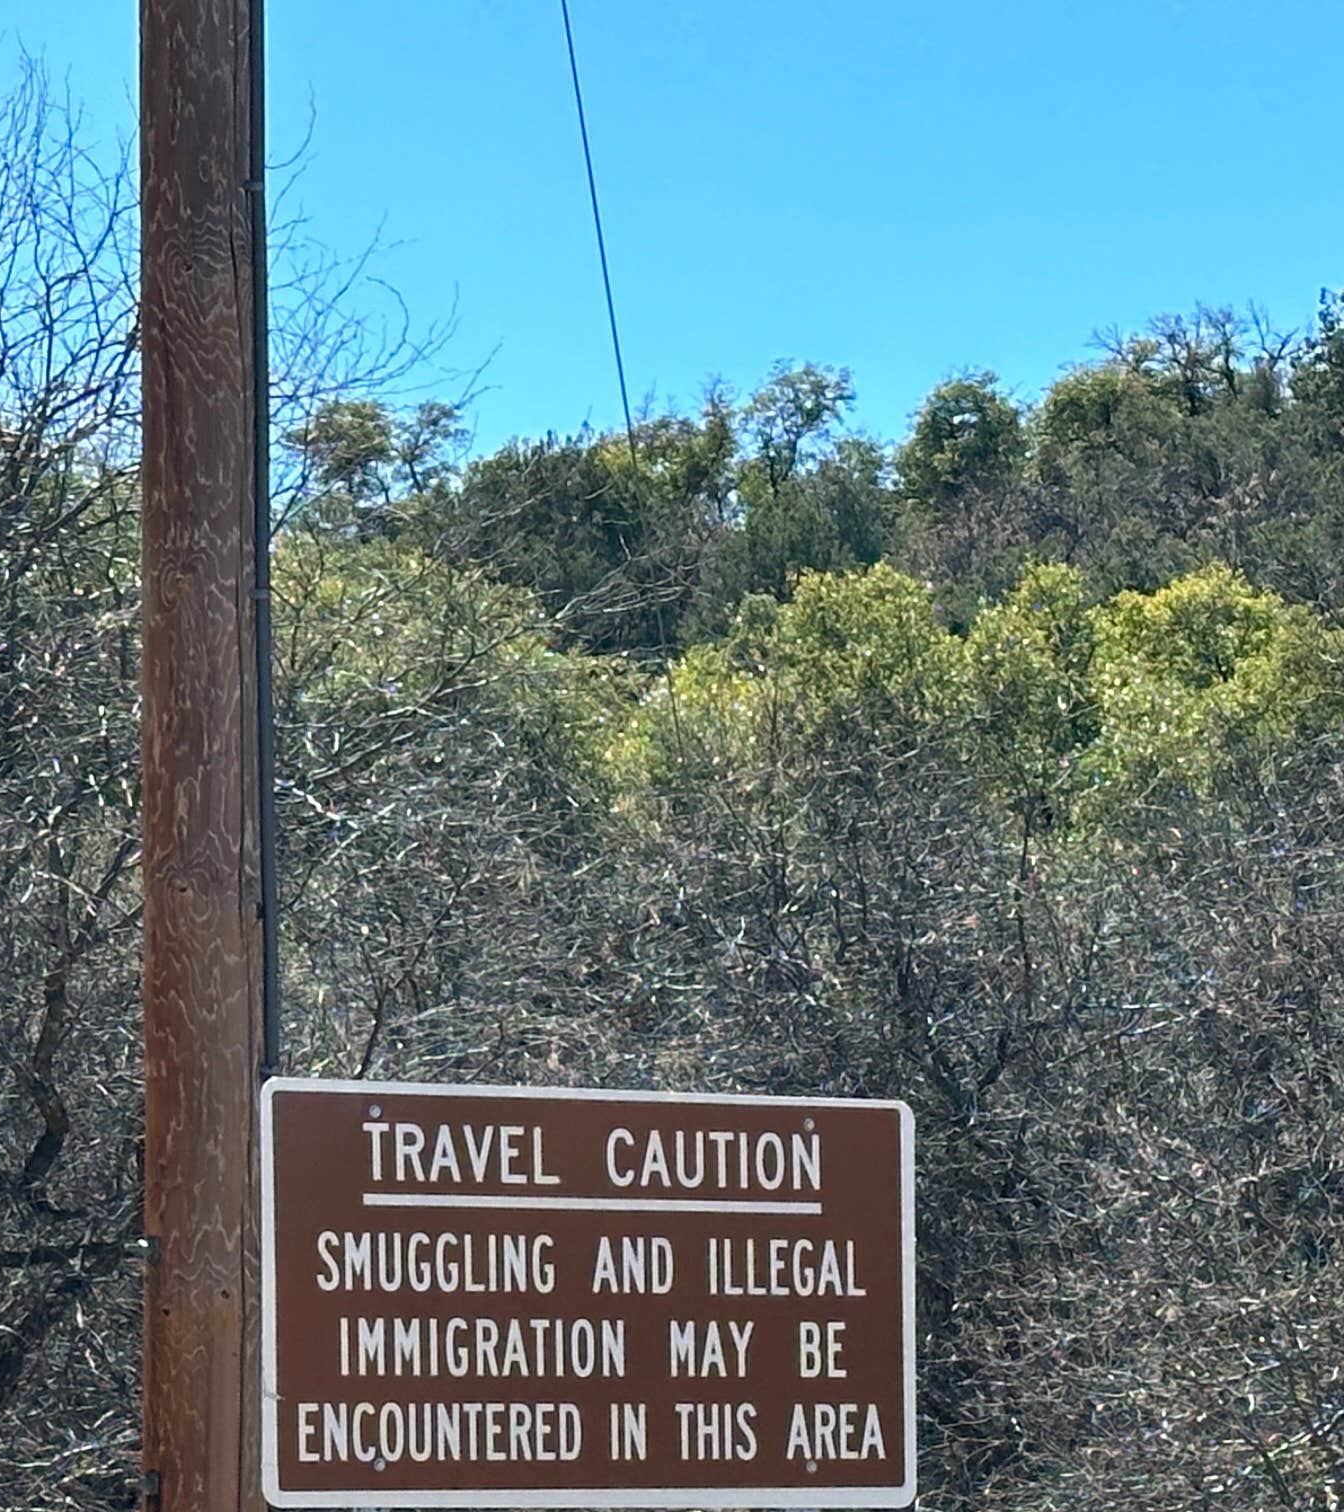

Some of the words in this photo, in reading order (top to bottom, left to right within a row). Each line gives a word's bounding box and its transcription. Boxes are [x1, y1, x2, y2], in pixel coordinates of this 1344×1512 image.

[363, 1122, 561, 1185] TRAVEL
[606, 1129, 821, 1190] CAUTION
[316, 1231, 555, 1293] SMUGGLING
[592, 1237, 674, 1294] AND
[709, 1239, 867, 1296] ILLEGAL
[340, 1317, 625, 1377] IMMIGRATION
[670, 1321, 754, 1378] MAY
[799, 1321, 847, 1378] BE
[298, 1402, 582, 1462] ENCOUNTERED
[611, 1403, 646, 1460] IN
[675, 1403, 757, 1461] THIS
[786, 1403, 886, 1460] AREA
